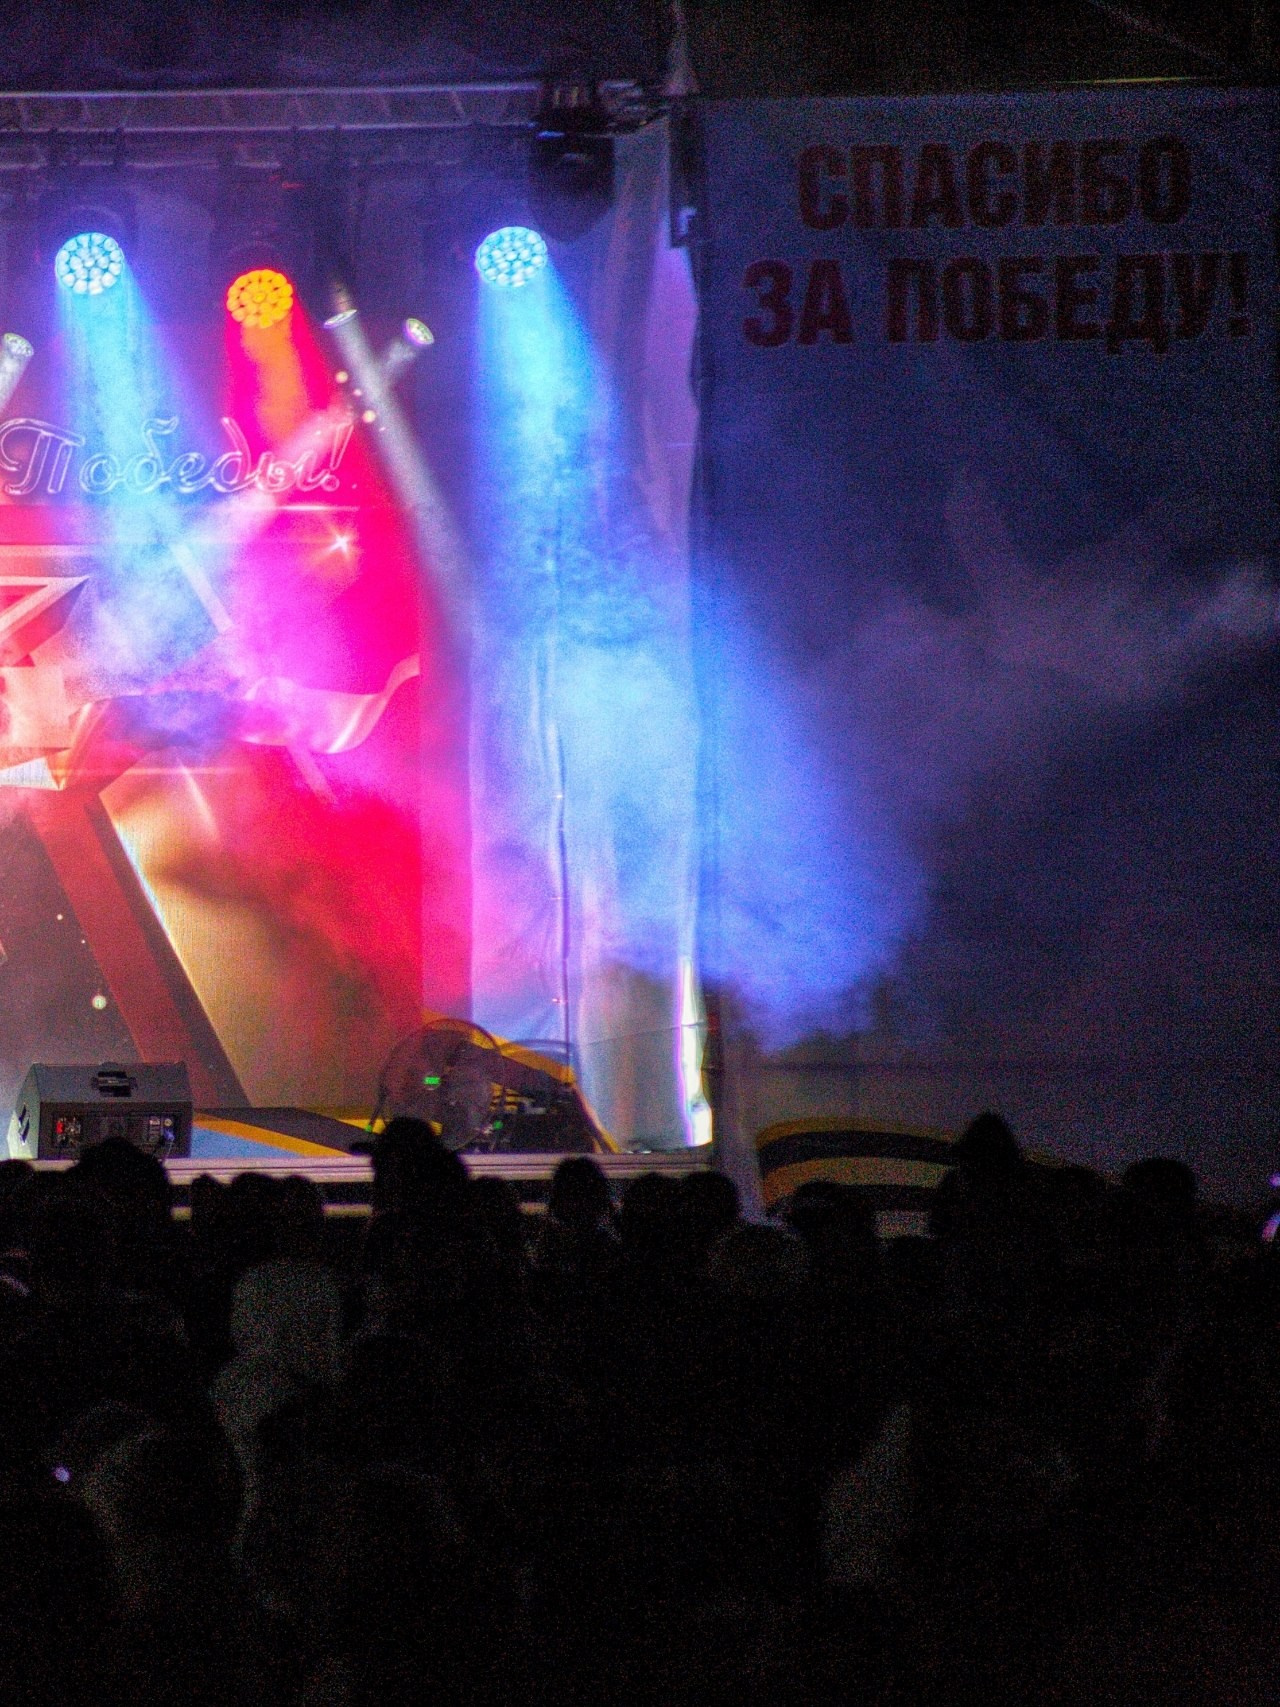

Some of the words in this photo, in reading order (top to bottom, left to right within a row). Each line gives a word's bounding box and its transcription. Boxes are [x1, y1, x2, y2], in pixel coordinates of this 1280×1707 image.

[796, 135, 1192, 231] СПАСИБО
[741, 259, 854, 347] ЗА
[885, 251, 1251, 355] ПОБЕДУ!
